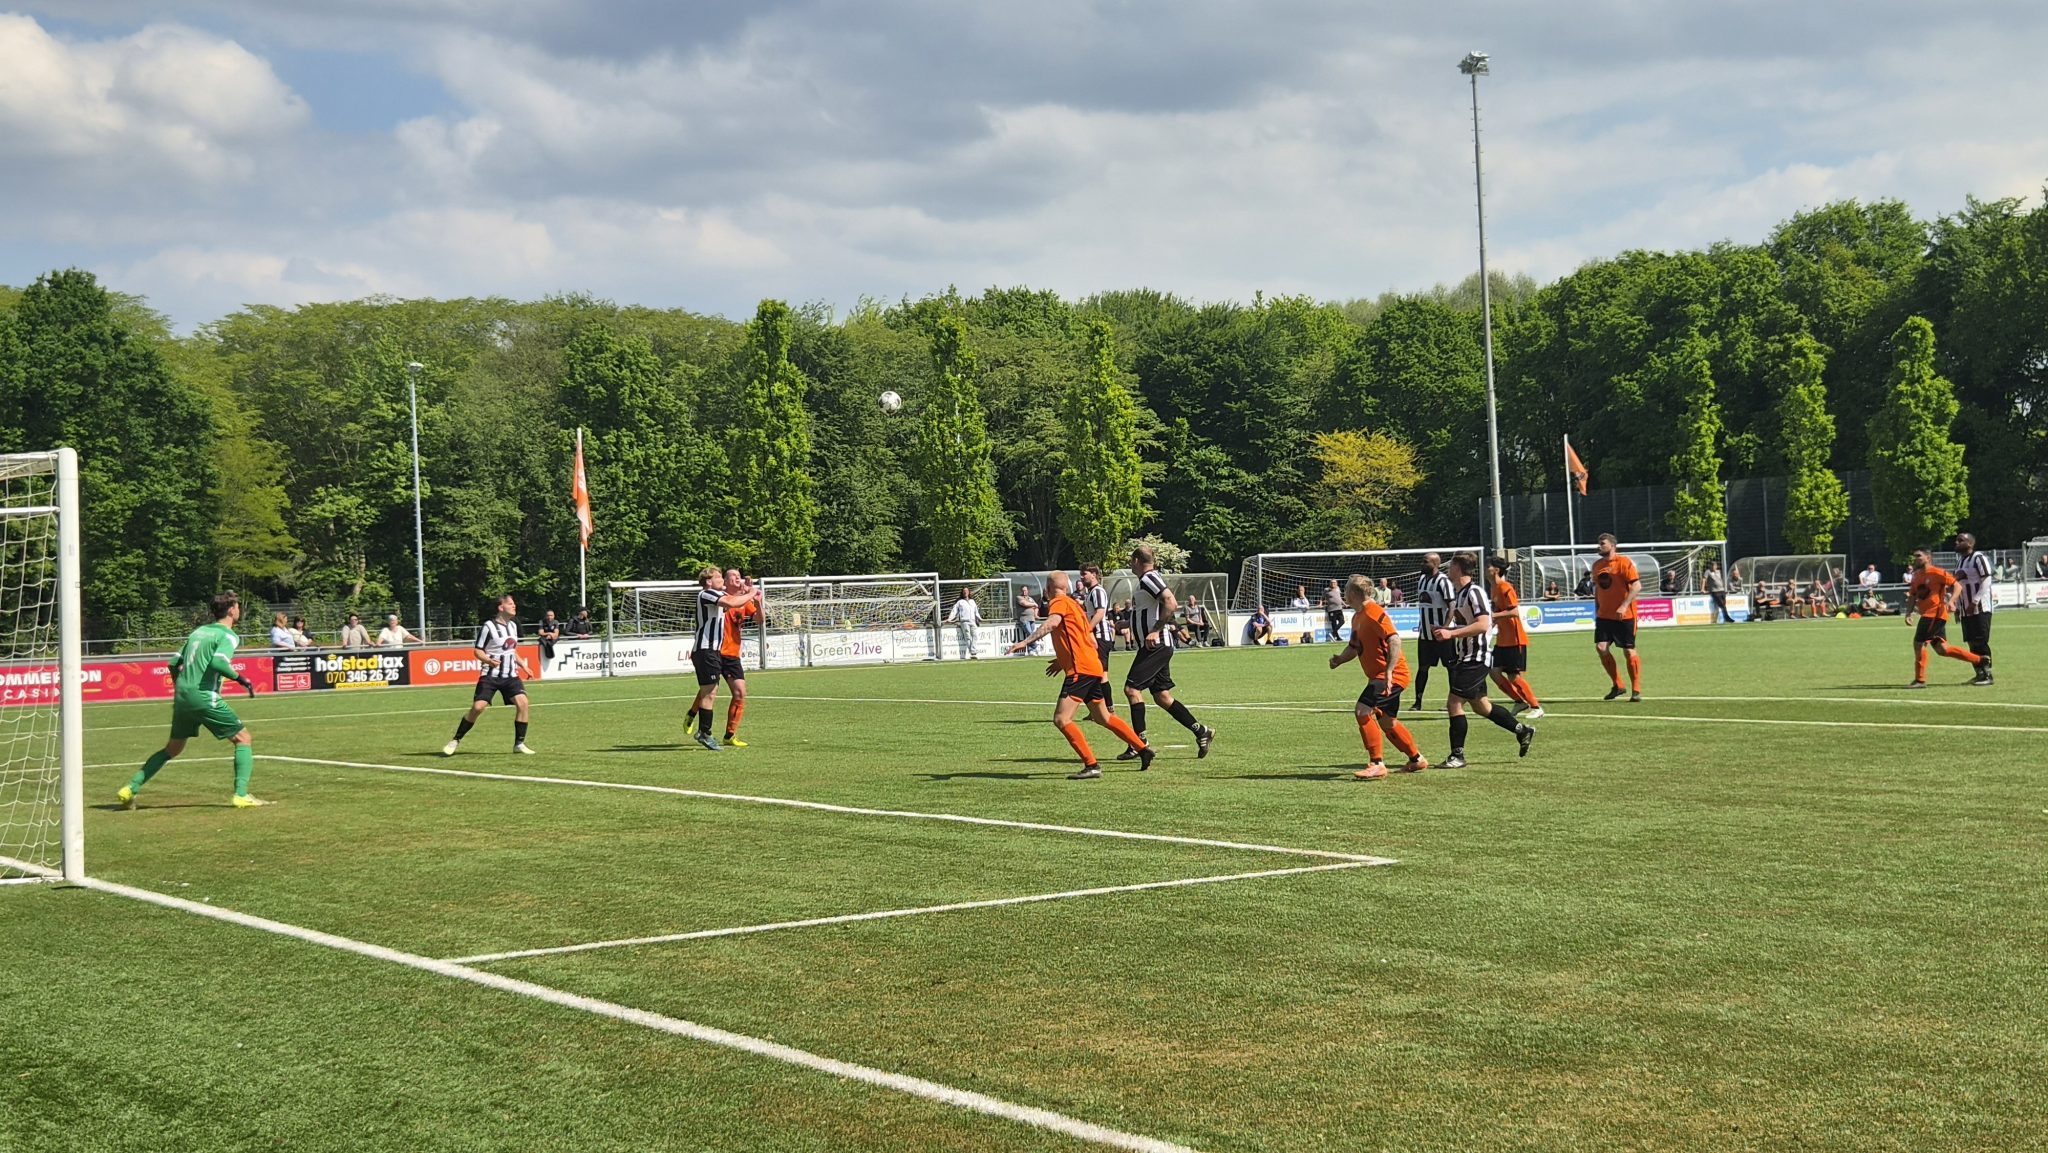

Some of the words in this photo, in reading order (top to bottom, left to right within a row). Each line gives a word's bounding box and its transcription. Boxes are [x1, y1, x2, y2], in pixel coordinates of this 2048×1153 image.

[812, 641, 882, 657] Green2live
[315, 654, 404, 672] hofstadtax
[326, 671, 346, 683] 070
[347, 670, 367, 682] 346
[369, 669, 383, 682] 26
[385, 668, 399, 681] 26
